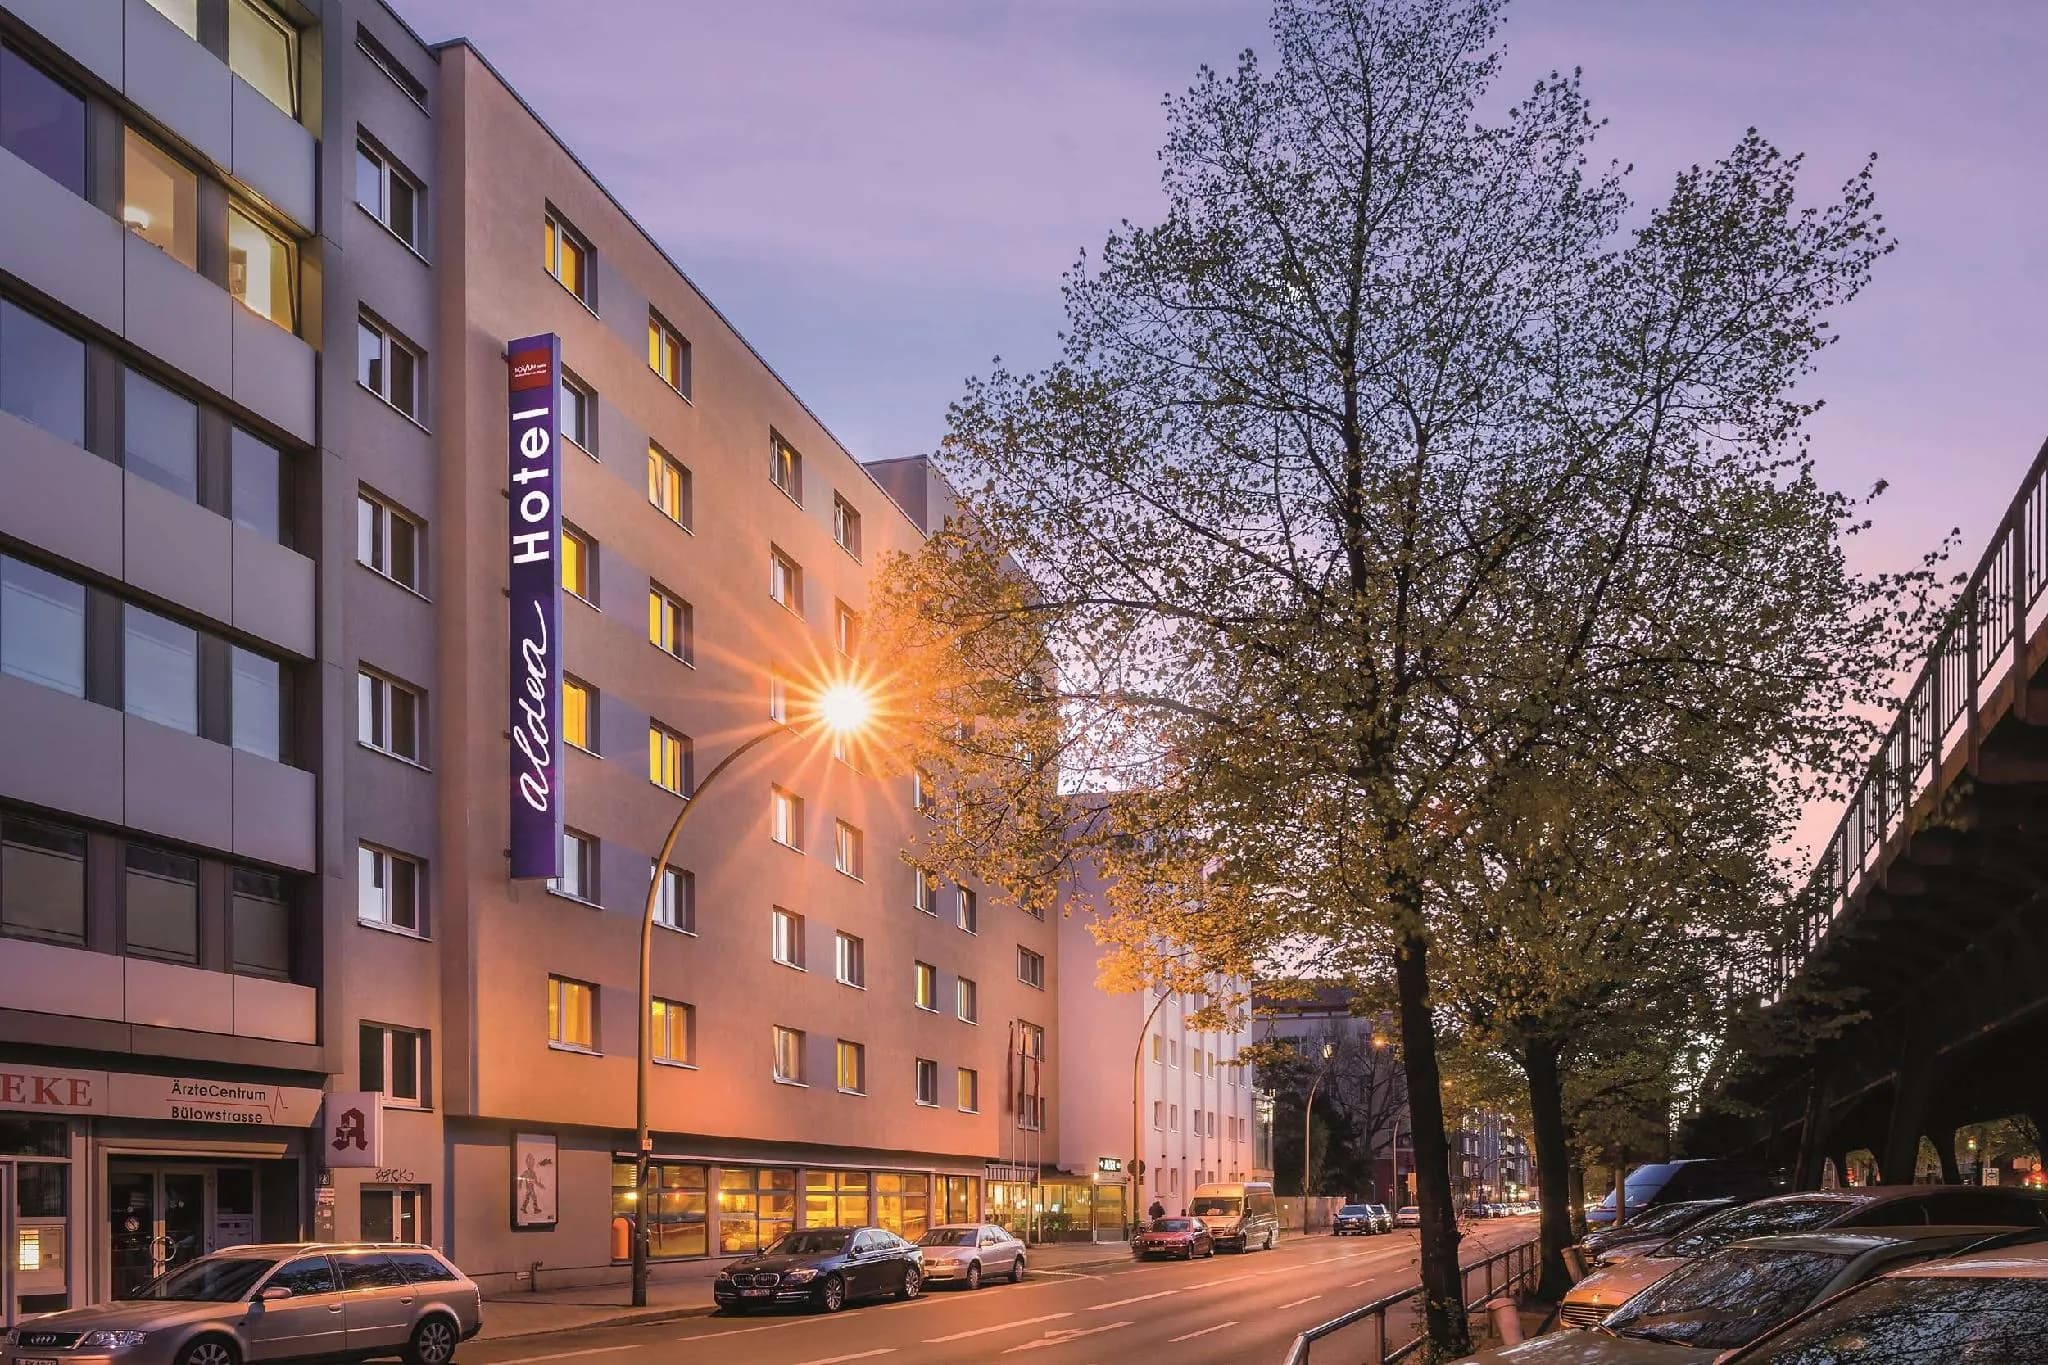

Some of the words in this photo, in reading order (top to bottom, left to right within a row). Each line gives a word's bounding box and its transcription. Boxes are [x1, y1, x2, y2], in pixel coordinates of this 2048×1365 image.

[512, 407, 550, 564] Hotel
[513, 600, 550, 812] aldea
[0, 1073, 93, 1107] EKE
[171, 1106, 263, 1123] Bülowstrasse
